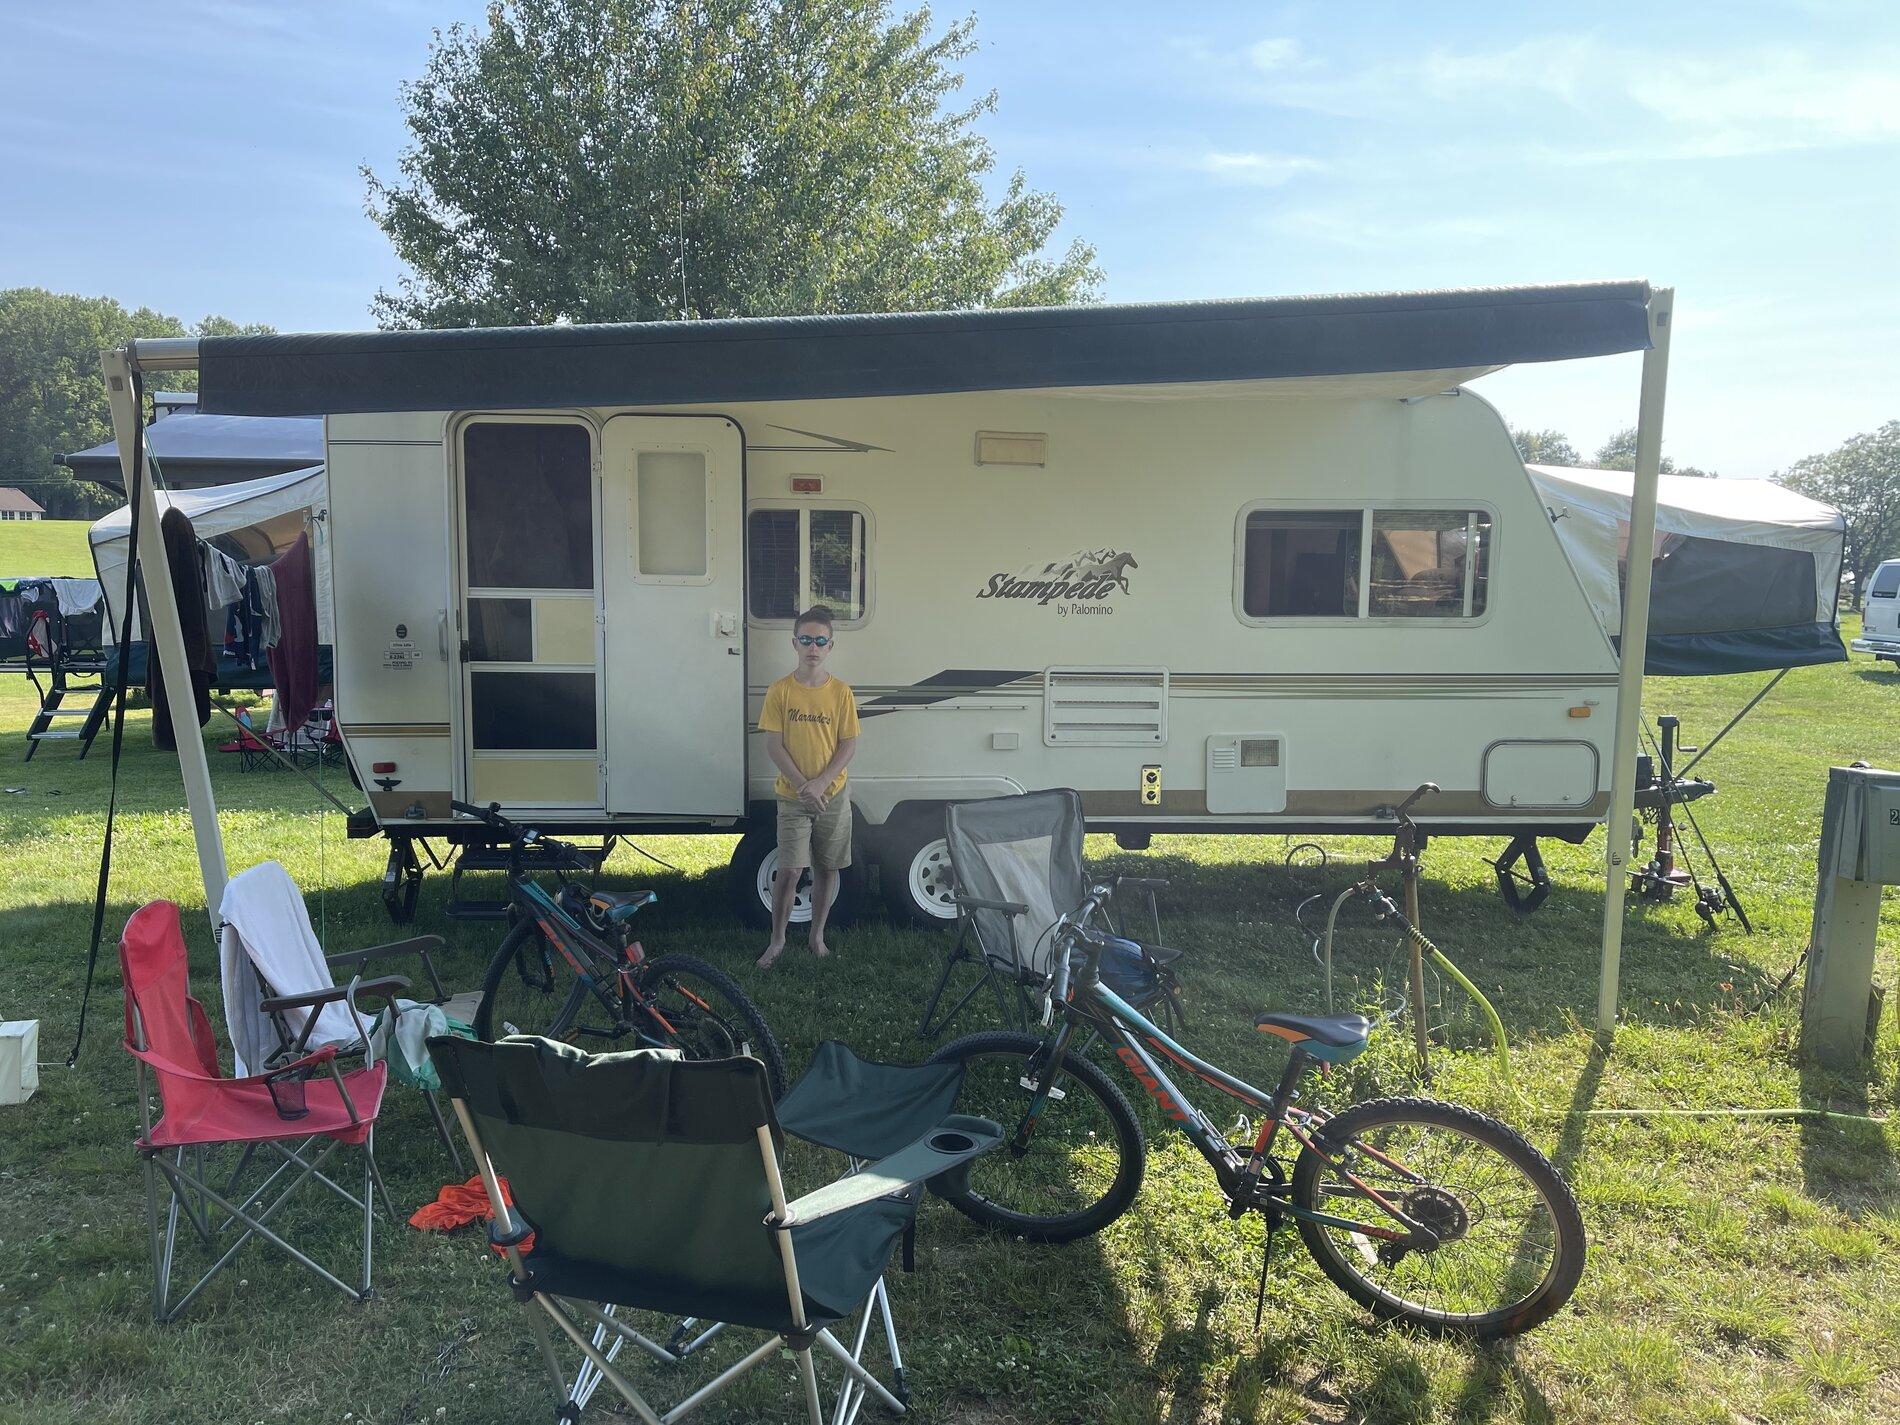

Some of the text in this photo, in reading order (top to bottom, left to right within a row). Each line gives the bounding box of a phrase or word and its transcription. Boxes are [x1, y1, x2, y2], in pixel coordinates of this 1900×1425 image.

[976, 573, 1116, 605] Stampede
[1057, 604, 1113, 617] by Palomino
[1116, 1047, 1190, 1123] GIANT
